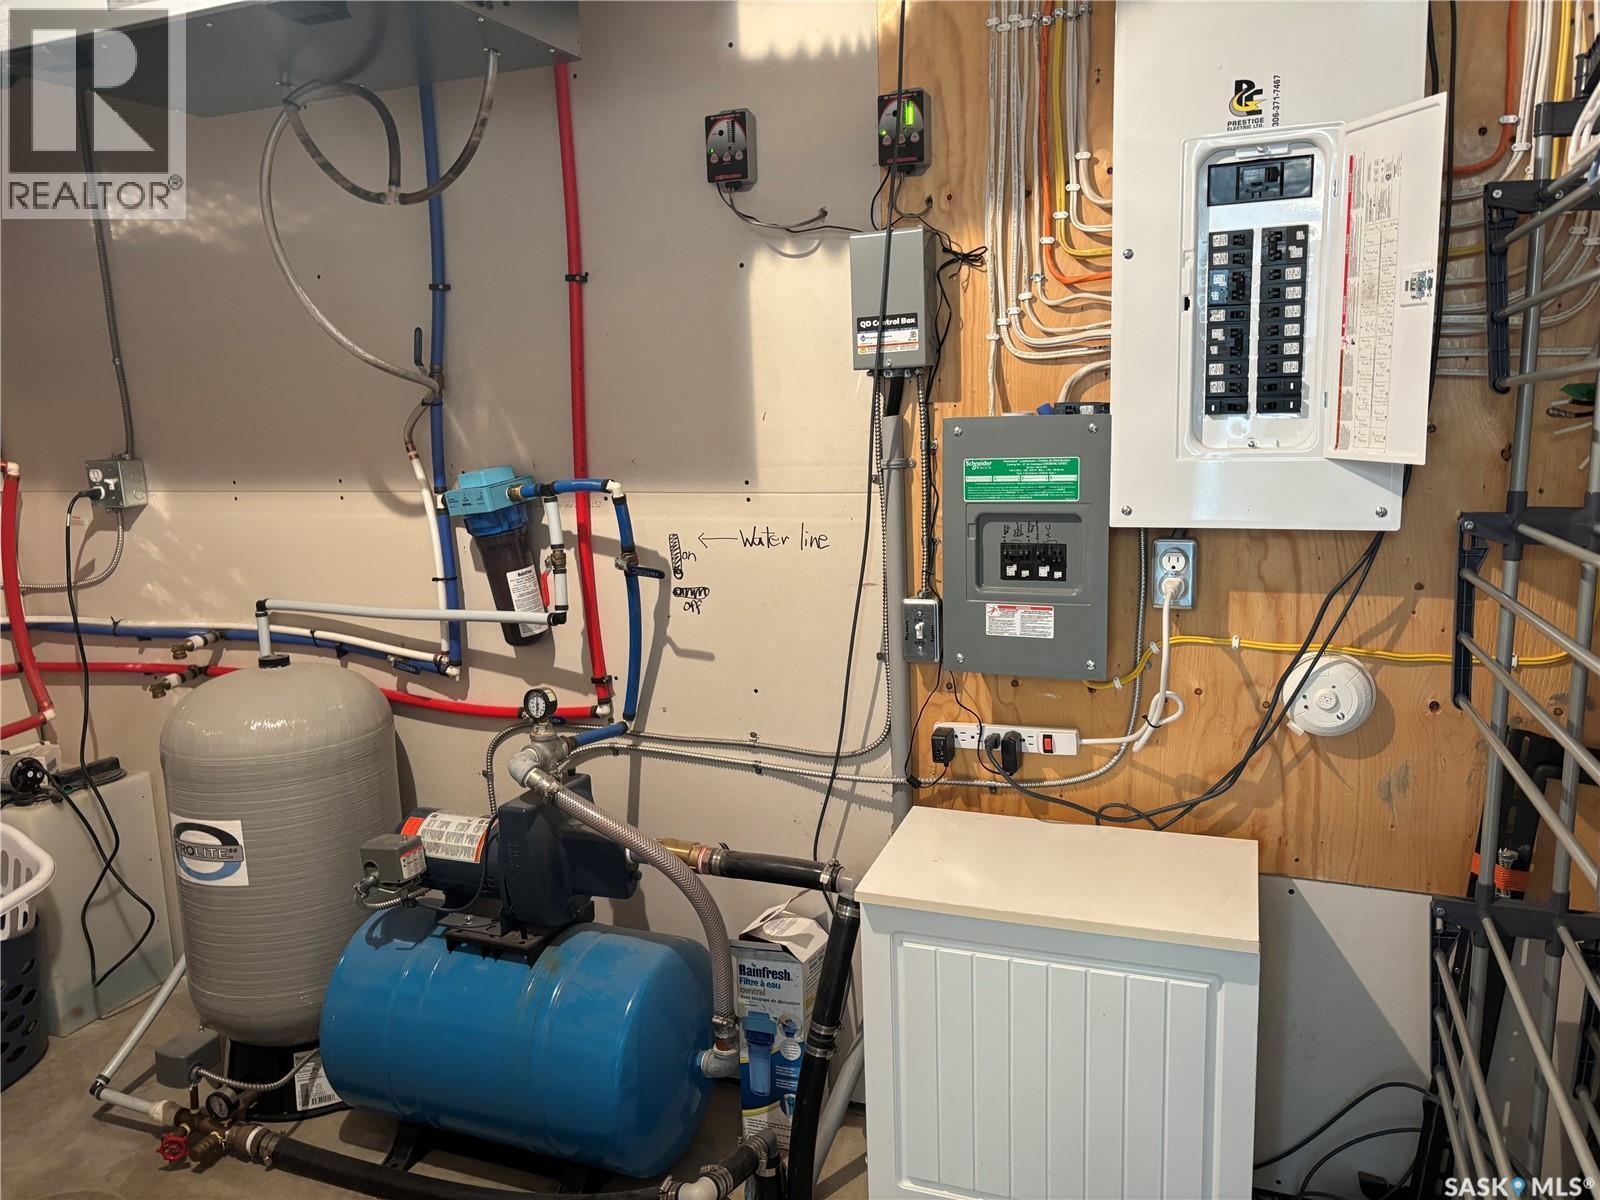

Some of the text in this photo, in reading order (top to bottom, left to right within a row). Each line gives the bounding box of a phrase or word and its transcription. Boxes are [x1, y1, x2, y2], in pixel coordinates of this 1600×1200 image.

[1227, 117, 1265, 127] PRESTIGE
[860, 320, 872, 329] QD
[900, 317, 916, 325] Box
[739, 522, 830, 551] Water line
[682, 551, 697, 562] on
[683, 600, 703, 615] off
[739, 963, 791, 982] Rainfresh
[739, 977, 759, 987] Filtre
[760, 979, 765, 988] à
